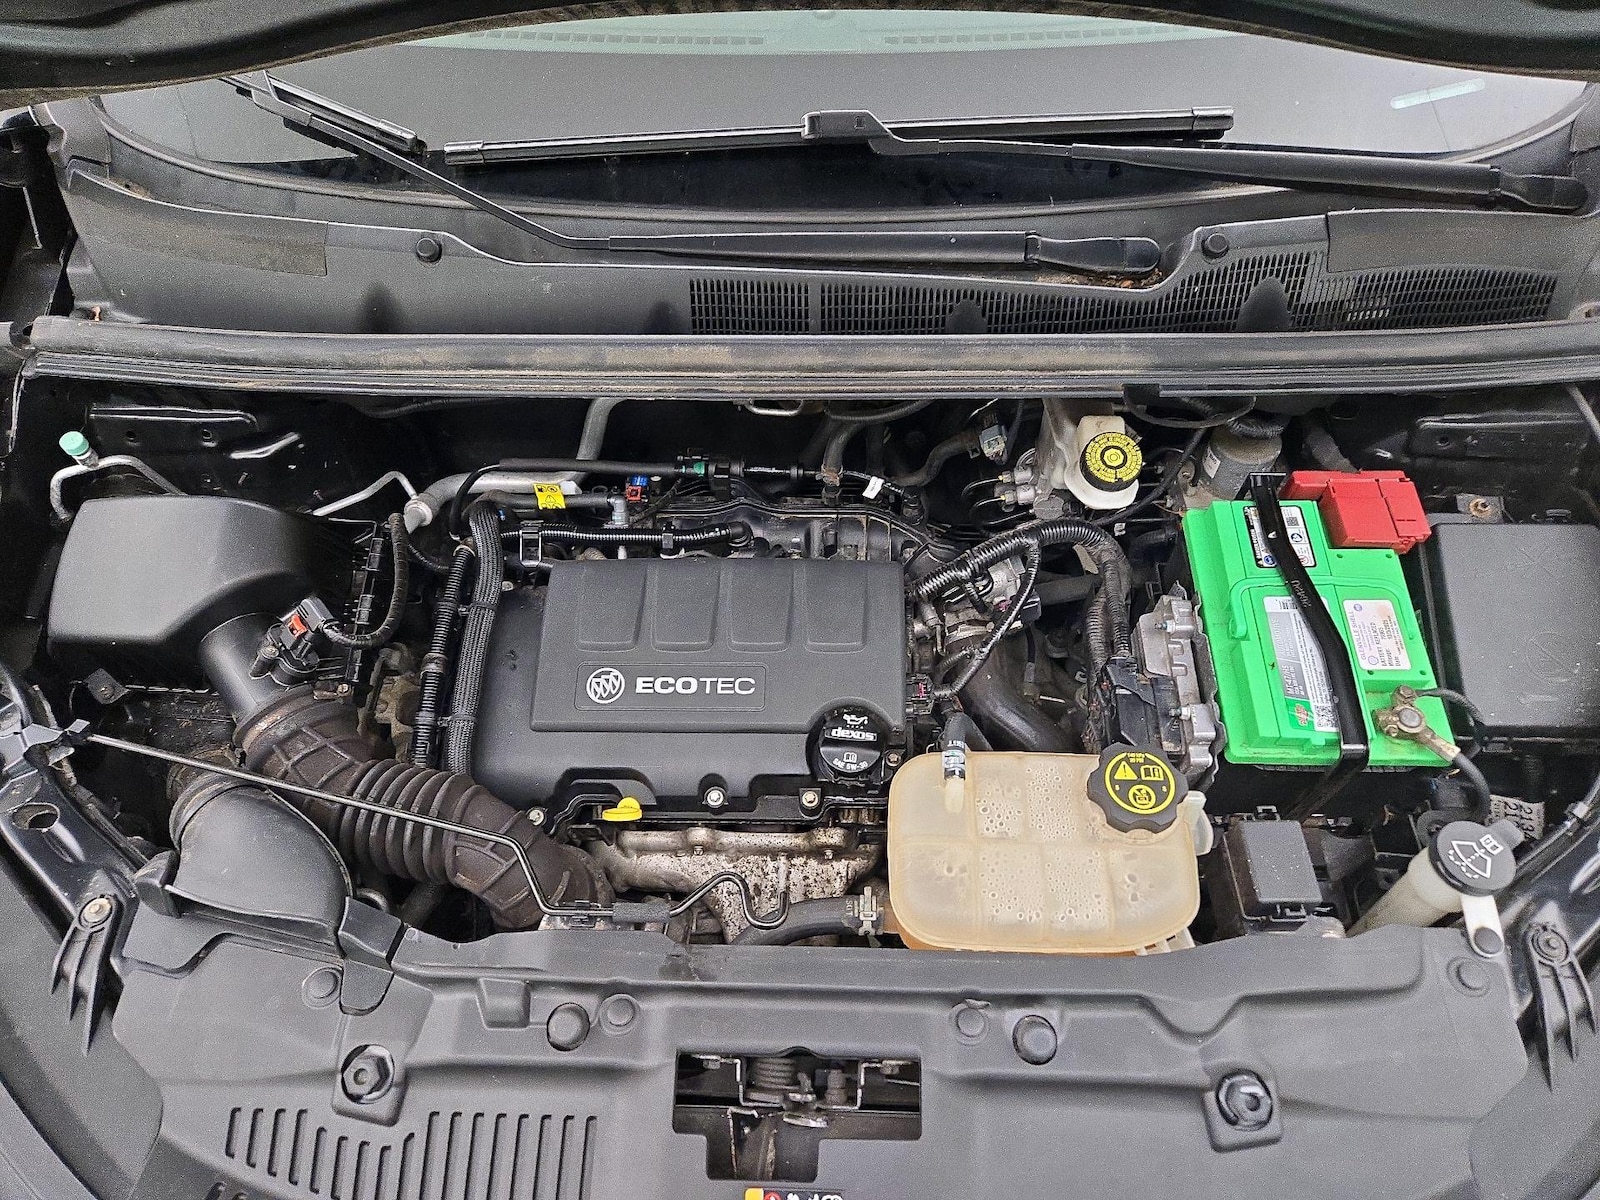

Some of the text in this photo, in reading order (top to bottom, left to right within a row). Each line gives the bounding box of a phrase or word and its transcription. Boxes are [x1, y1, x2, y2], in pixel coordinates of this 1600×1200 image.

[635, 676, 756, 695] ECOTEC
[831, 727, 874, 741] dexos
[832, 758, 846, 769] SAE
